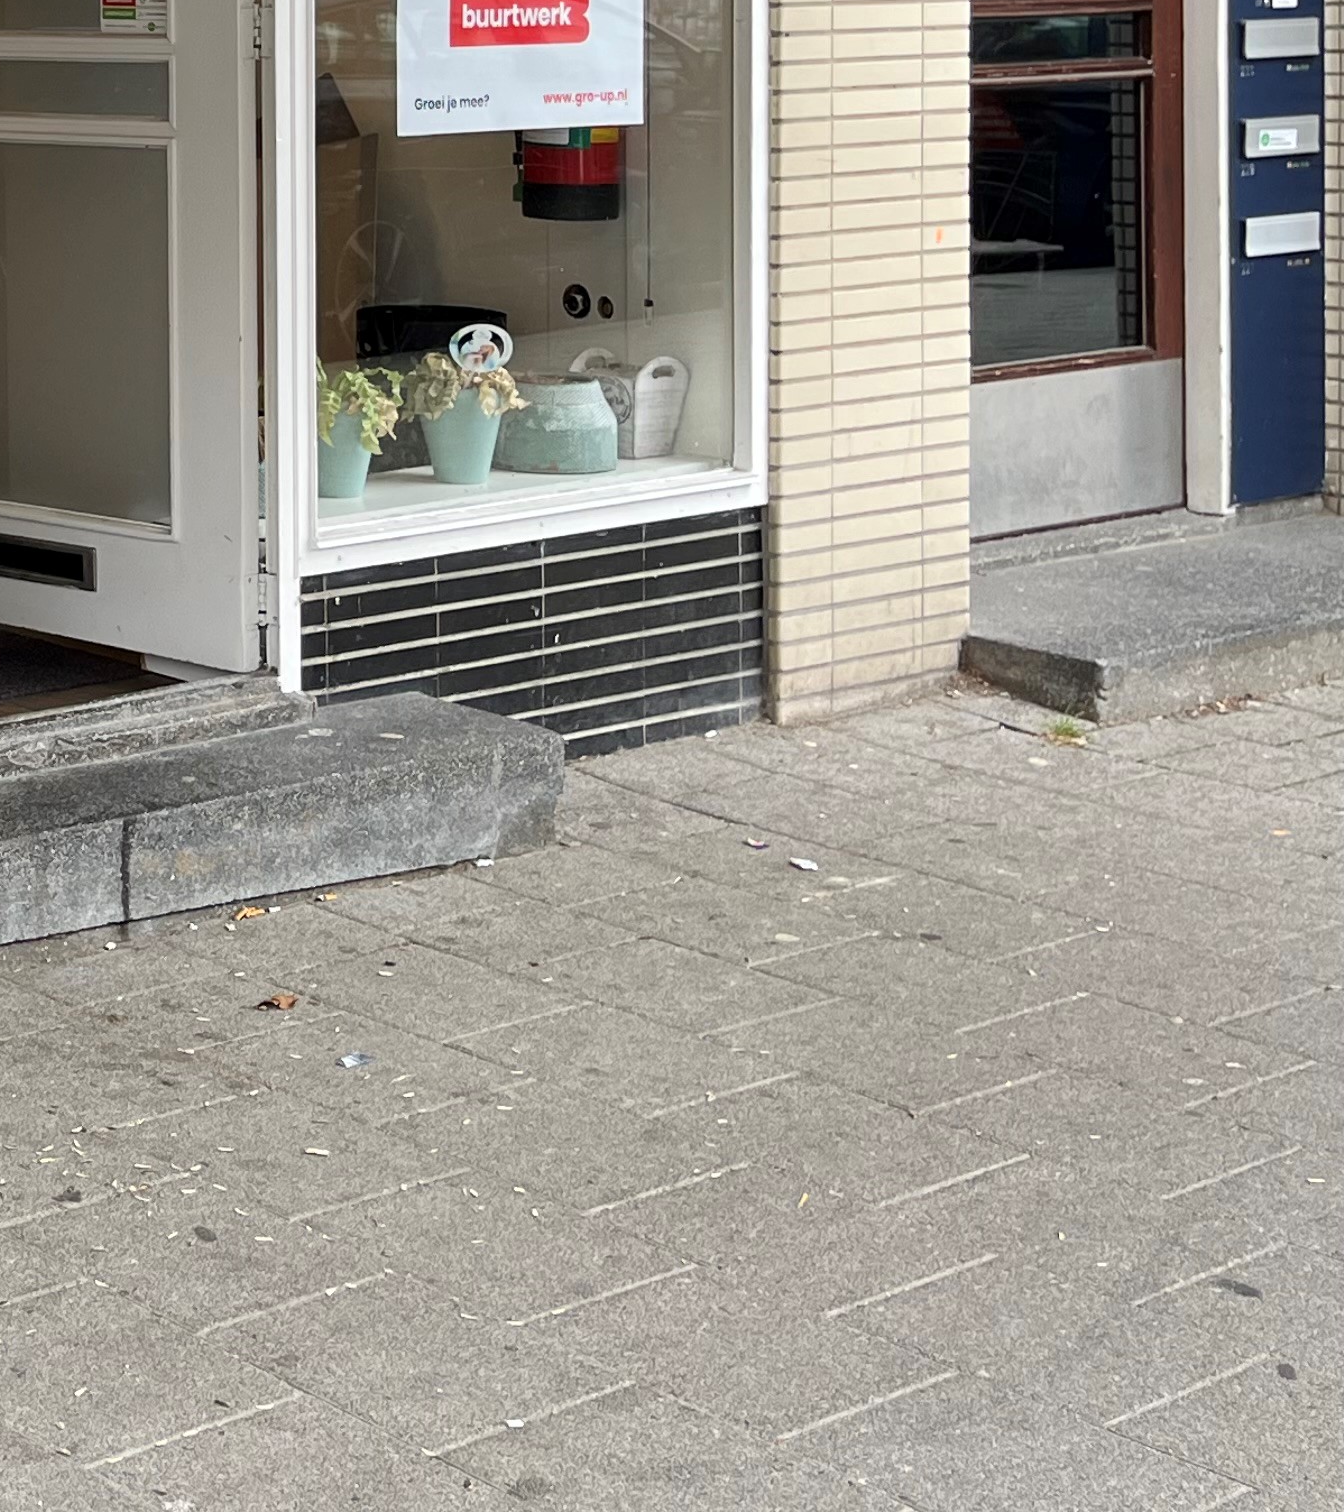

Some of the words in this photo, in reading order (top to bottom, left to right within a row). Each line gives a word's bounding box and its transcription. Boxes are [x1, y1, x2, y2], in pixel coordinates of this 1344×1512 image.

[461, 1, 572, 29] buurtwerk
[414, 96, 445, 111] Groei
[446, 97, 458, 114] je
[459, 95, 491, 109] mee?
[543, 88, 629, 108] www.gro-up.nl
